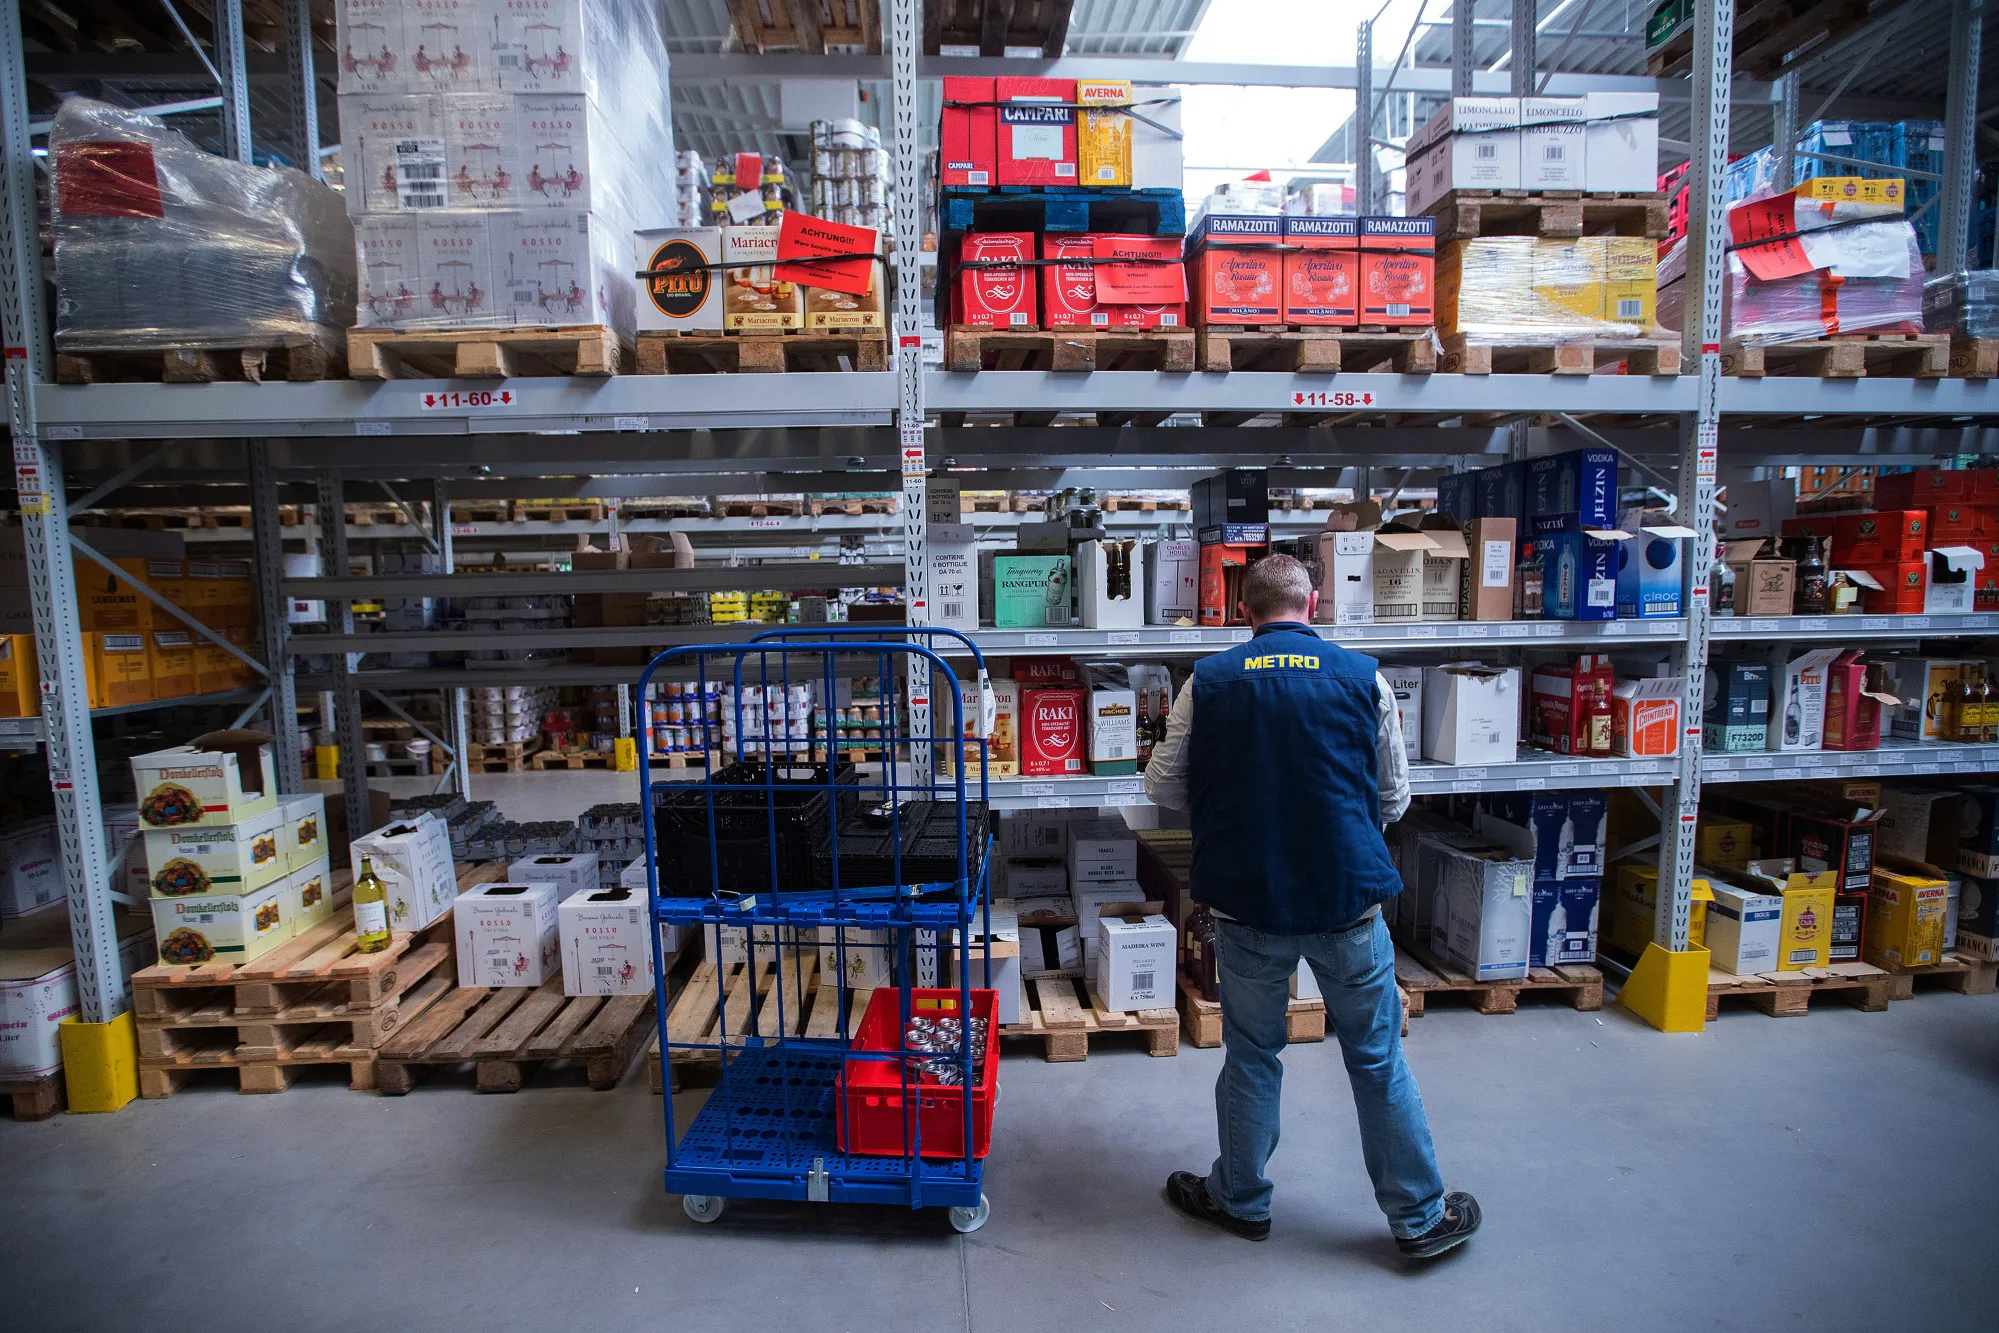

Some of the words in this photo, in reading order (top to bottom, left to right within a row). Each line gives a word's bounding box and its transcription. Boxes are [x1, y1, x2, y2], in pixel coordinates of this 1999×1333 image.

[1084, 88, 1124, 98] AVERNA
[1005, 107, 1069, 121] CAMPARI
[1458, 105, 1516, 115] LIMONCELLO
[1526, 107, 1583, 118] LIMONCELLO
[531, 120, 573, 129] ROSSO
[1526, 124, 1582, 136] MADRUZZO
[948, 162, 973, 170] CAMPARI
[1213, 219, 1277, 233] RAMAZZOTTI
[1291, 221, 1354, 234] RAMAZZOTTI
[1367, 220, 1430, 233] RAMAZZOTTI
[522, 237, 562, 246] ROSSO
[731, 236, 779, 249] Mariacr
[800, 227, 855, 245] ACHTUNG!!!
[433, 239, 473, 247] ROSSO
[1112, 250, 1162, 259] ACHTUNG!!!
[1062, 255, 1093, 270] RAK
[1220, 258, 1266, 275] Aperitivo
[1298, 259, 1343, 276] Aperitivo
[1374, 257, 1419, 275] Aperitivo
[653, 269, 704, 294] PITÚ
[439, 391, 498, 408] 11-60-
[1307, 392, 1361, 406] 11-58-
[1587, 453, 1614, 463] VODKA
[1531, 459, 1557, 472] VODKA
[1594, 468, 1606, 521] JELZIN
[1588, 539, 1615, 547] VODKA
[1006, 567, 1044, 576] Tanqueray
[1373, 567, 1421, 575] LAGAVULIN
[1001, 580, 1048, 588] RANGPUR
[1460, 557, 1471, 616] DIAGEO
[1244, 653, 1320, 670] METRO
[1030, 664, 1061, 677] RAKI
[1393, 679, 1419, 689] Liter
[1039, 706, 1073, 720] RAKI
[1639, 707, 1674, 726] COINTREAU
[1100, 719, 1131, 727] WILLIAMS
[1732, 733, 1764, 742] F7320D
[1917, 888, 1945, 898] AVERNA
